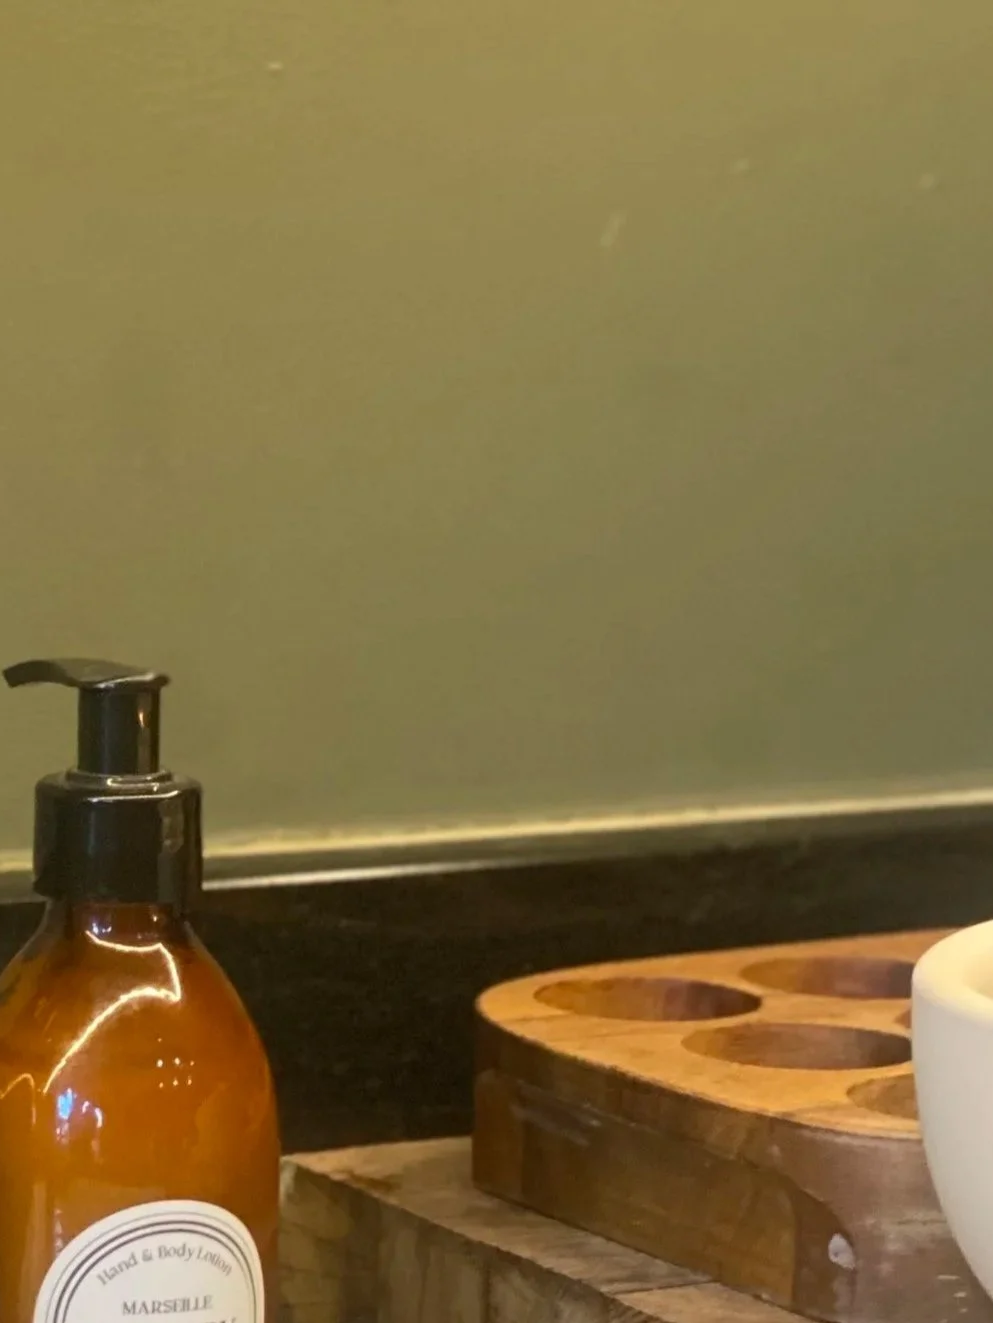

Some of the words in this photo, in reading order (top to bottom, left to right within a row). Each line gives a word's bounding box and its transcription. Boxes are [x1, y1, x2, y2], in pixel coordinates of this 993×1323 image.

[96, 1252, 138, 1286] Hand
[142, 1248, 154, 1261] &
[158, 1243, 195, 1260] Body
[196, 1245, 233, 1277] Lotion
[122, 1295, 213, 1316] MARSEILLE
